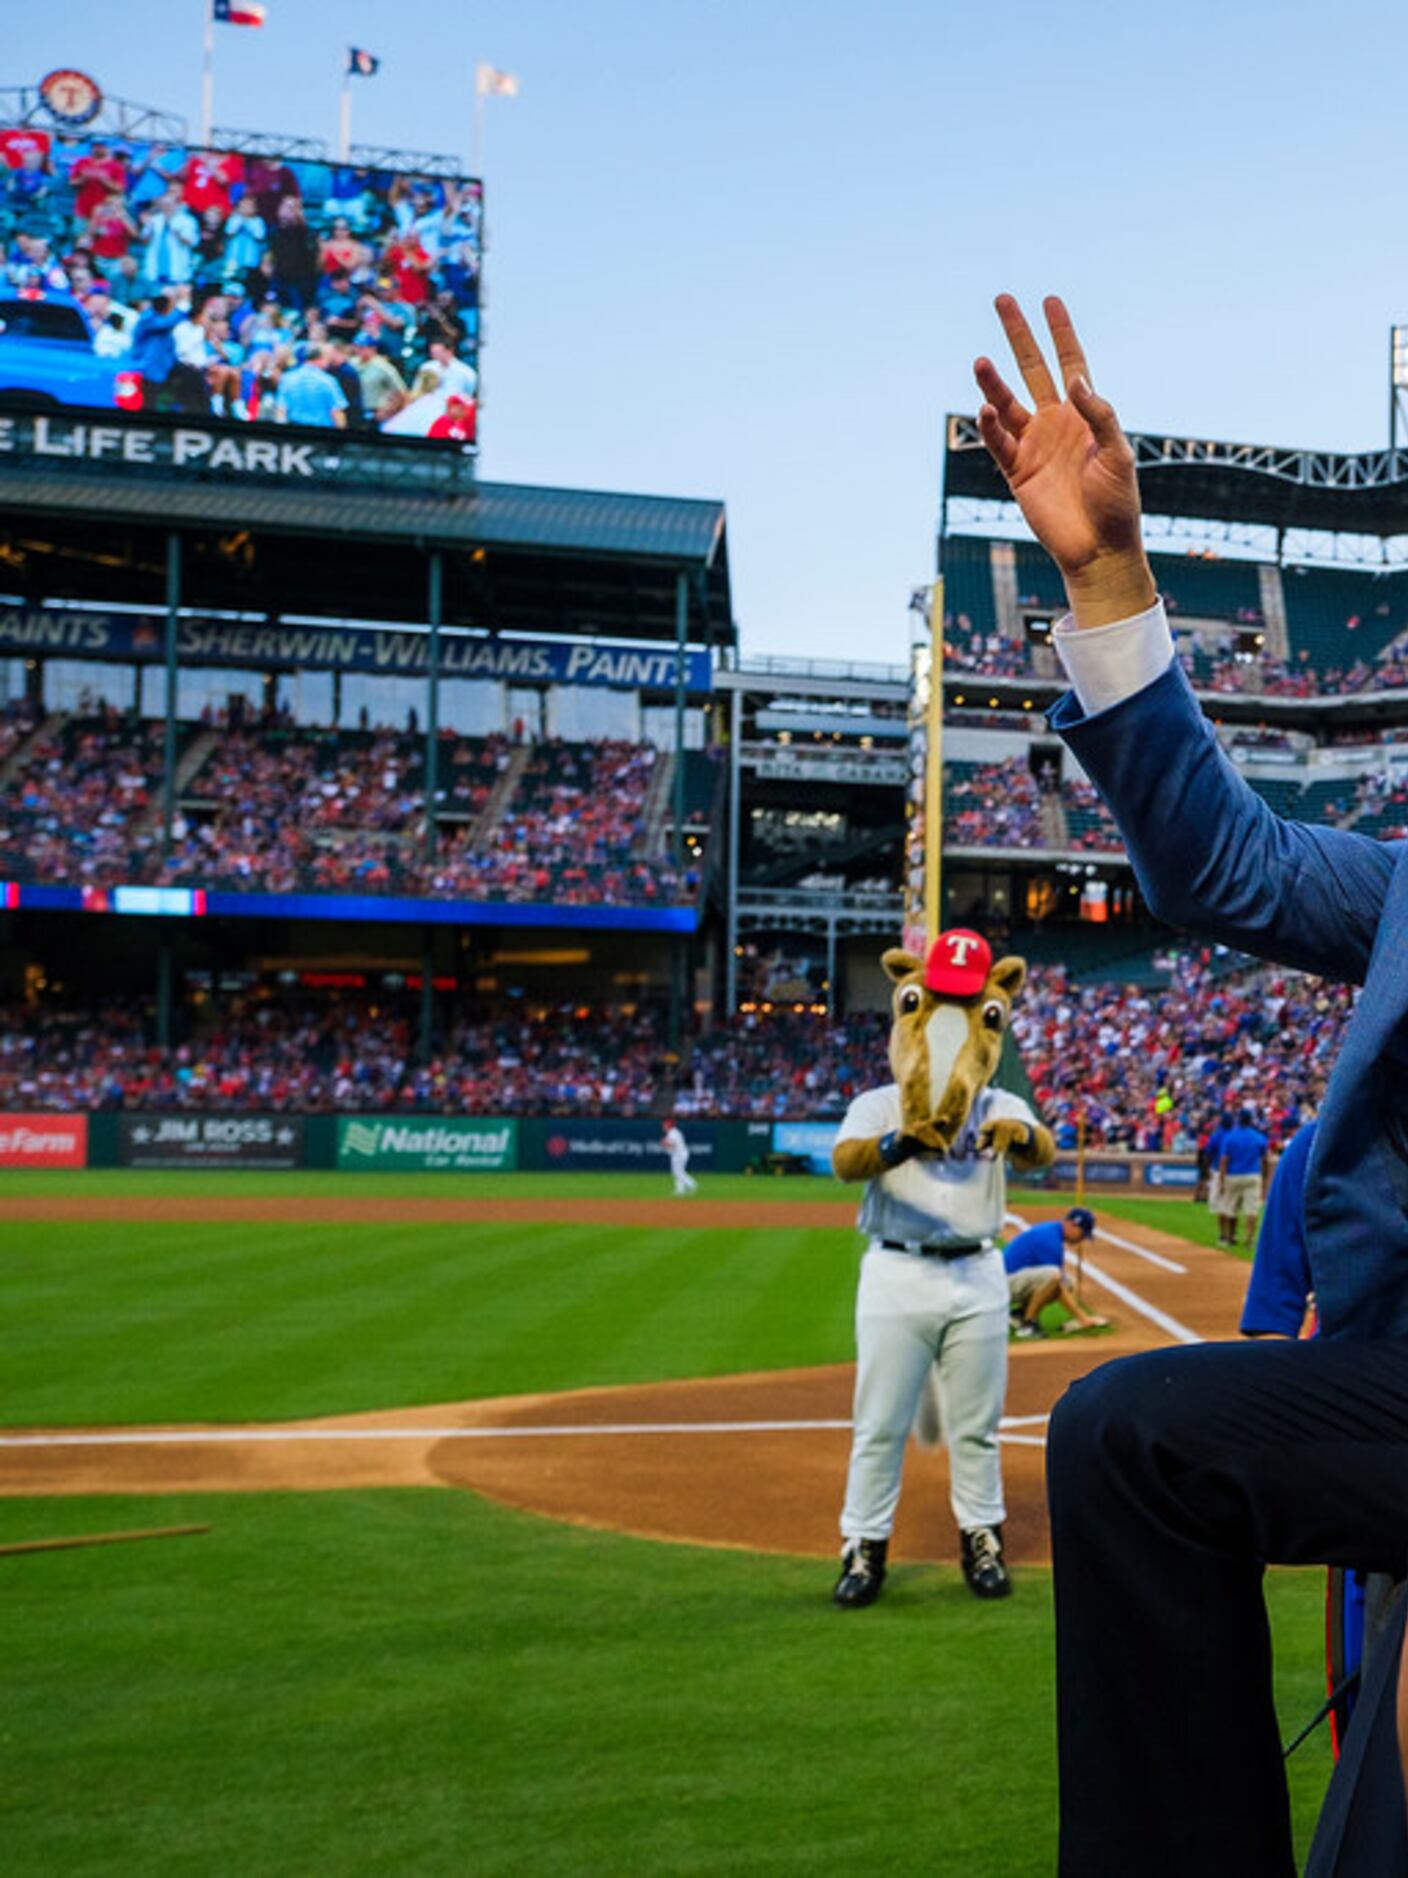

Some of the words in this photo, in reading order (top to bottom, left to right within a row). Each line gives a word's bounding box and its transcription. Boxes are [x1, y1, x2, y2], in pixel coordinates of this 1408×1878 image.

[32, 416, 156, 463] LIFE
[173, 428, 314, 476] PARK
[565, 644, 692, 686] PAINTS
[947, 935, 978, 966] T
[154, 1119, 198, 1142] JIM
[203, 1118, 274, 1143] ROSS
[380, 1126, 510, 1154] National
